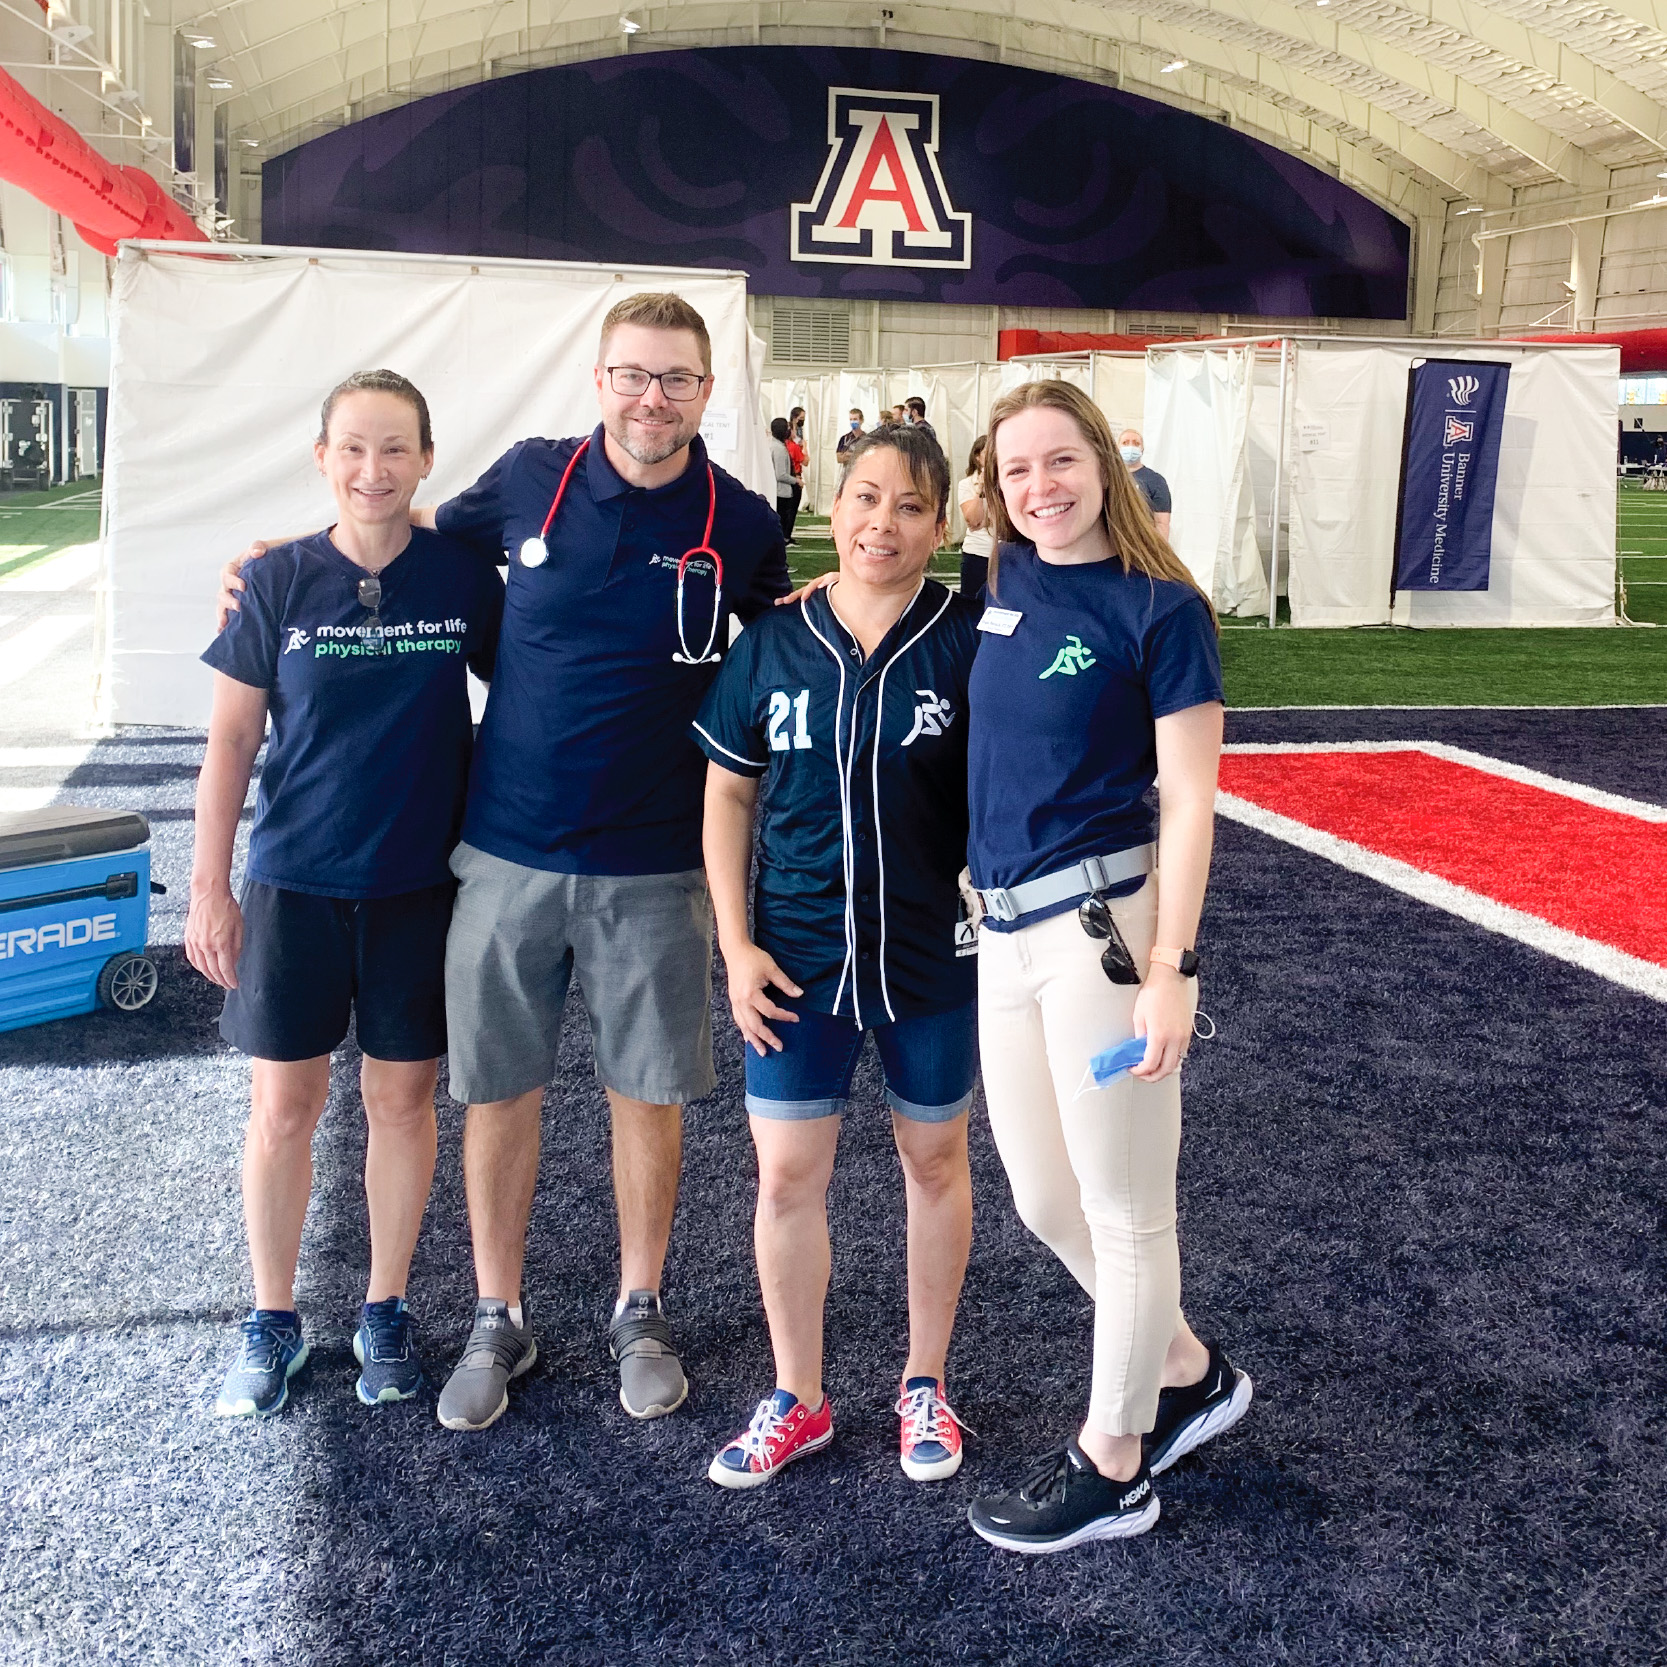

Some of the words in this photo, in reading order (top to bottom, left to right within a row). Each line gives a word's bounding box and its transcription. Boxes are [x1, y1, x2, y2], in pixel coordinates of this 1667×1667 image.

[790, 86, 972, 270] A
[1432, 453, 1455, 521] University
[1454, 453, 1471, 501] Banner
[1429, 523, 1447, 584] Medicine
[395, 639, 462, 654] therapy
[417, 620, 443, 635] for
[444, 618, 467, 634] life
[768, 689, 813, 751] 21
[1120, 1479, 1150, 1510] HOKA
